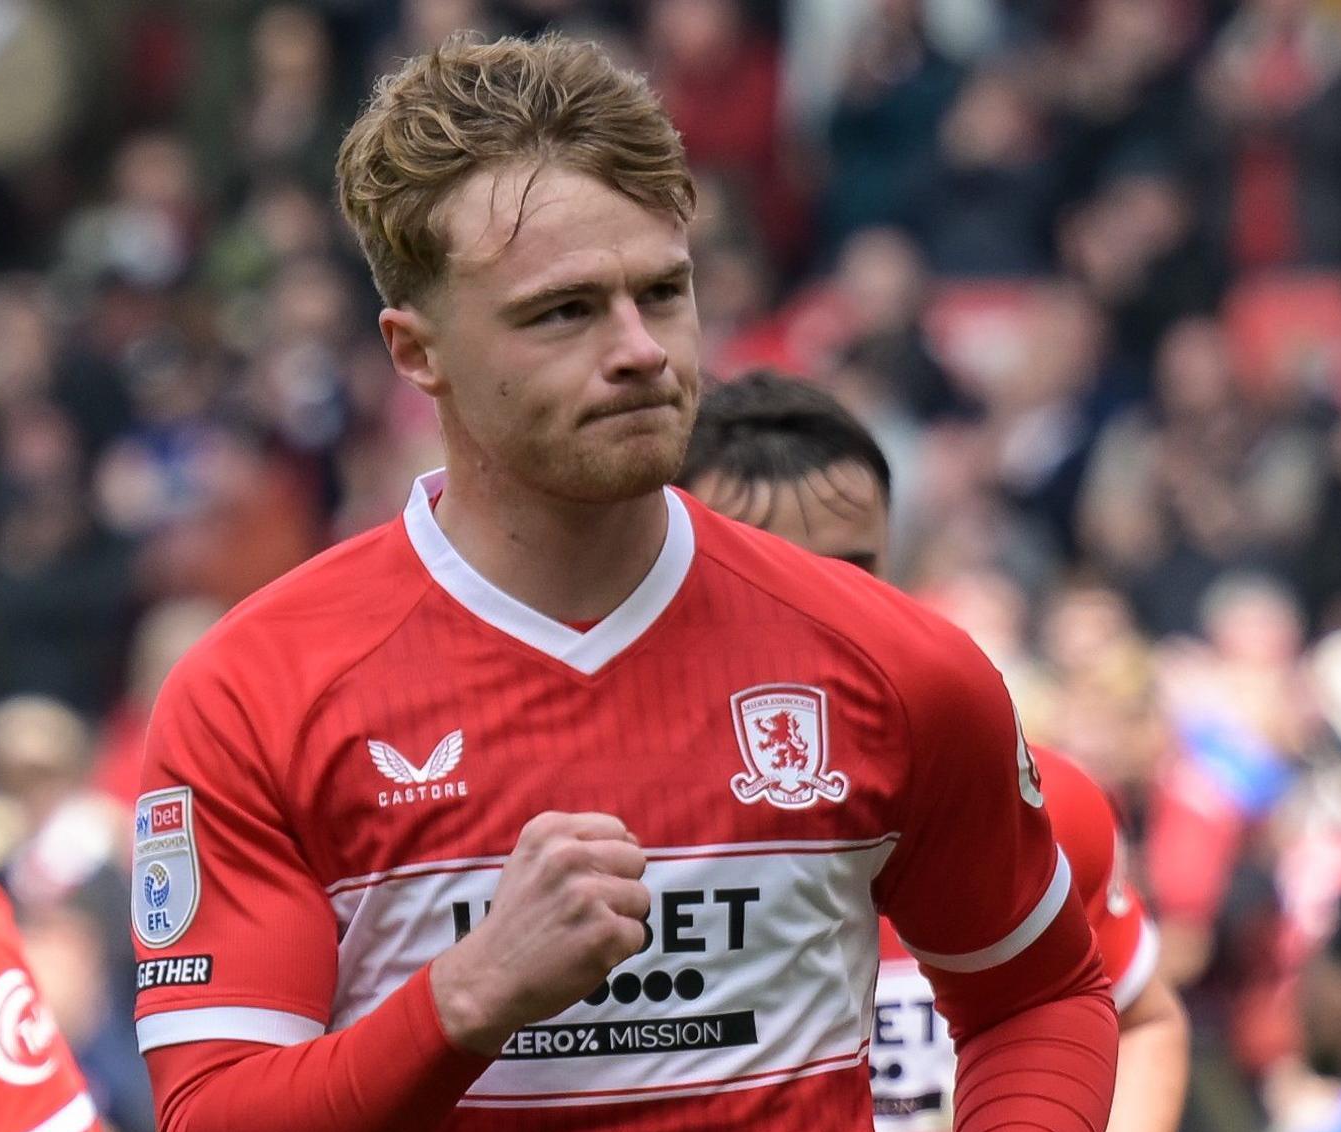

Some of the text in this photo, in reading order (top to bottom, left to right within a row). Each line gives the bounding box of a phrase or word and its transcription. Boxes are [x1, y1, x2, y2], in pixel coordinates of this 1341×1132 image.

[378, 781, 467, 807] CASTORE
[152, 805, 180, 828] bet
[147, 911, 171, 931] EFL
[501, 1020, 723, 1055] ZERO% MISSION
